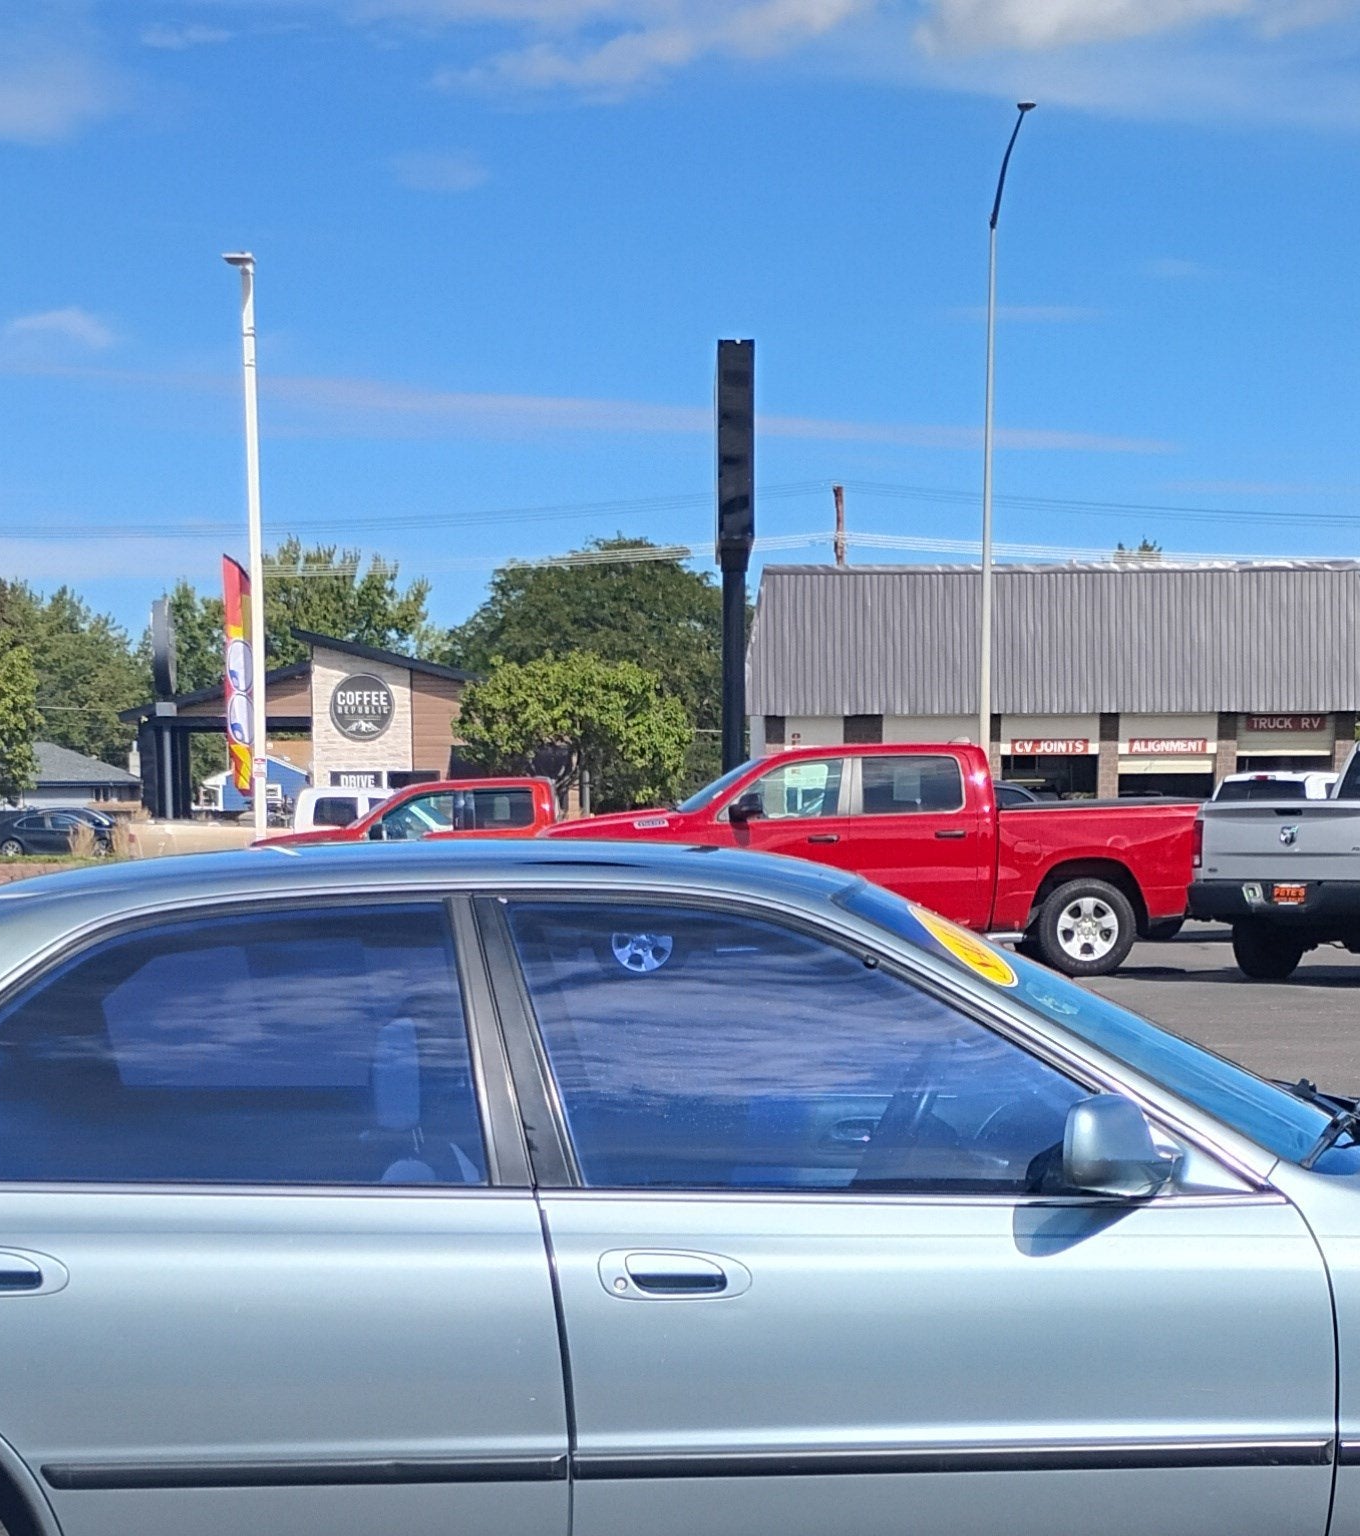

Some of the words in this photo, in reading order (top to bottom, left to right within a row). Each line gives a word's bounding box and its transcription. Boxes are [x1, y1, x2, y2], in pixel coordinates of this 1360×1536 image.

[337, 691, 388, 706] COFFEE
[1252, 717, 1292, 729] TRUCK
[1301, 717, 1321, 729] RV
[1015, 741, 1035, 753] CV
[1036, 740, 1084, 753] JOINTS
[1131, 739, 1204, 753] ALIGNMENT
[340, 774, 375, 788] DRIVE
